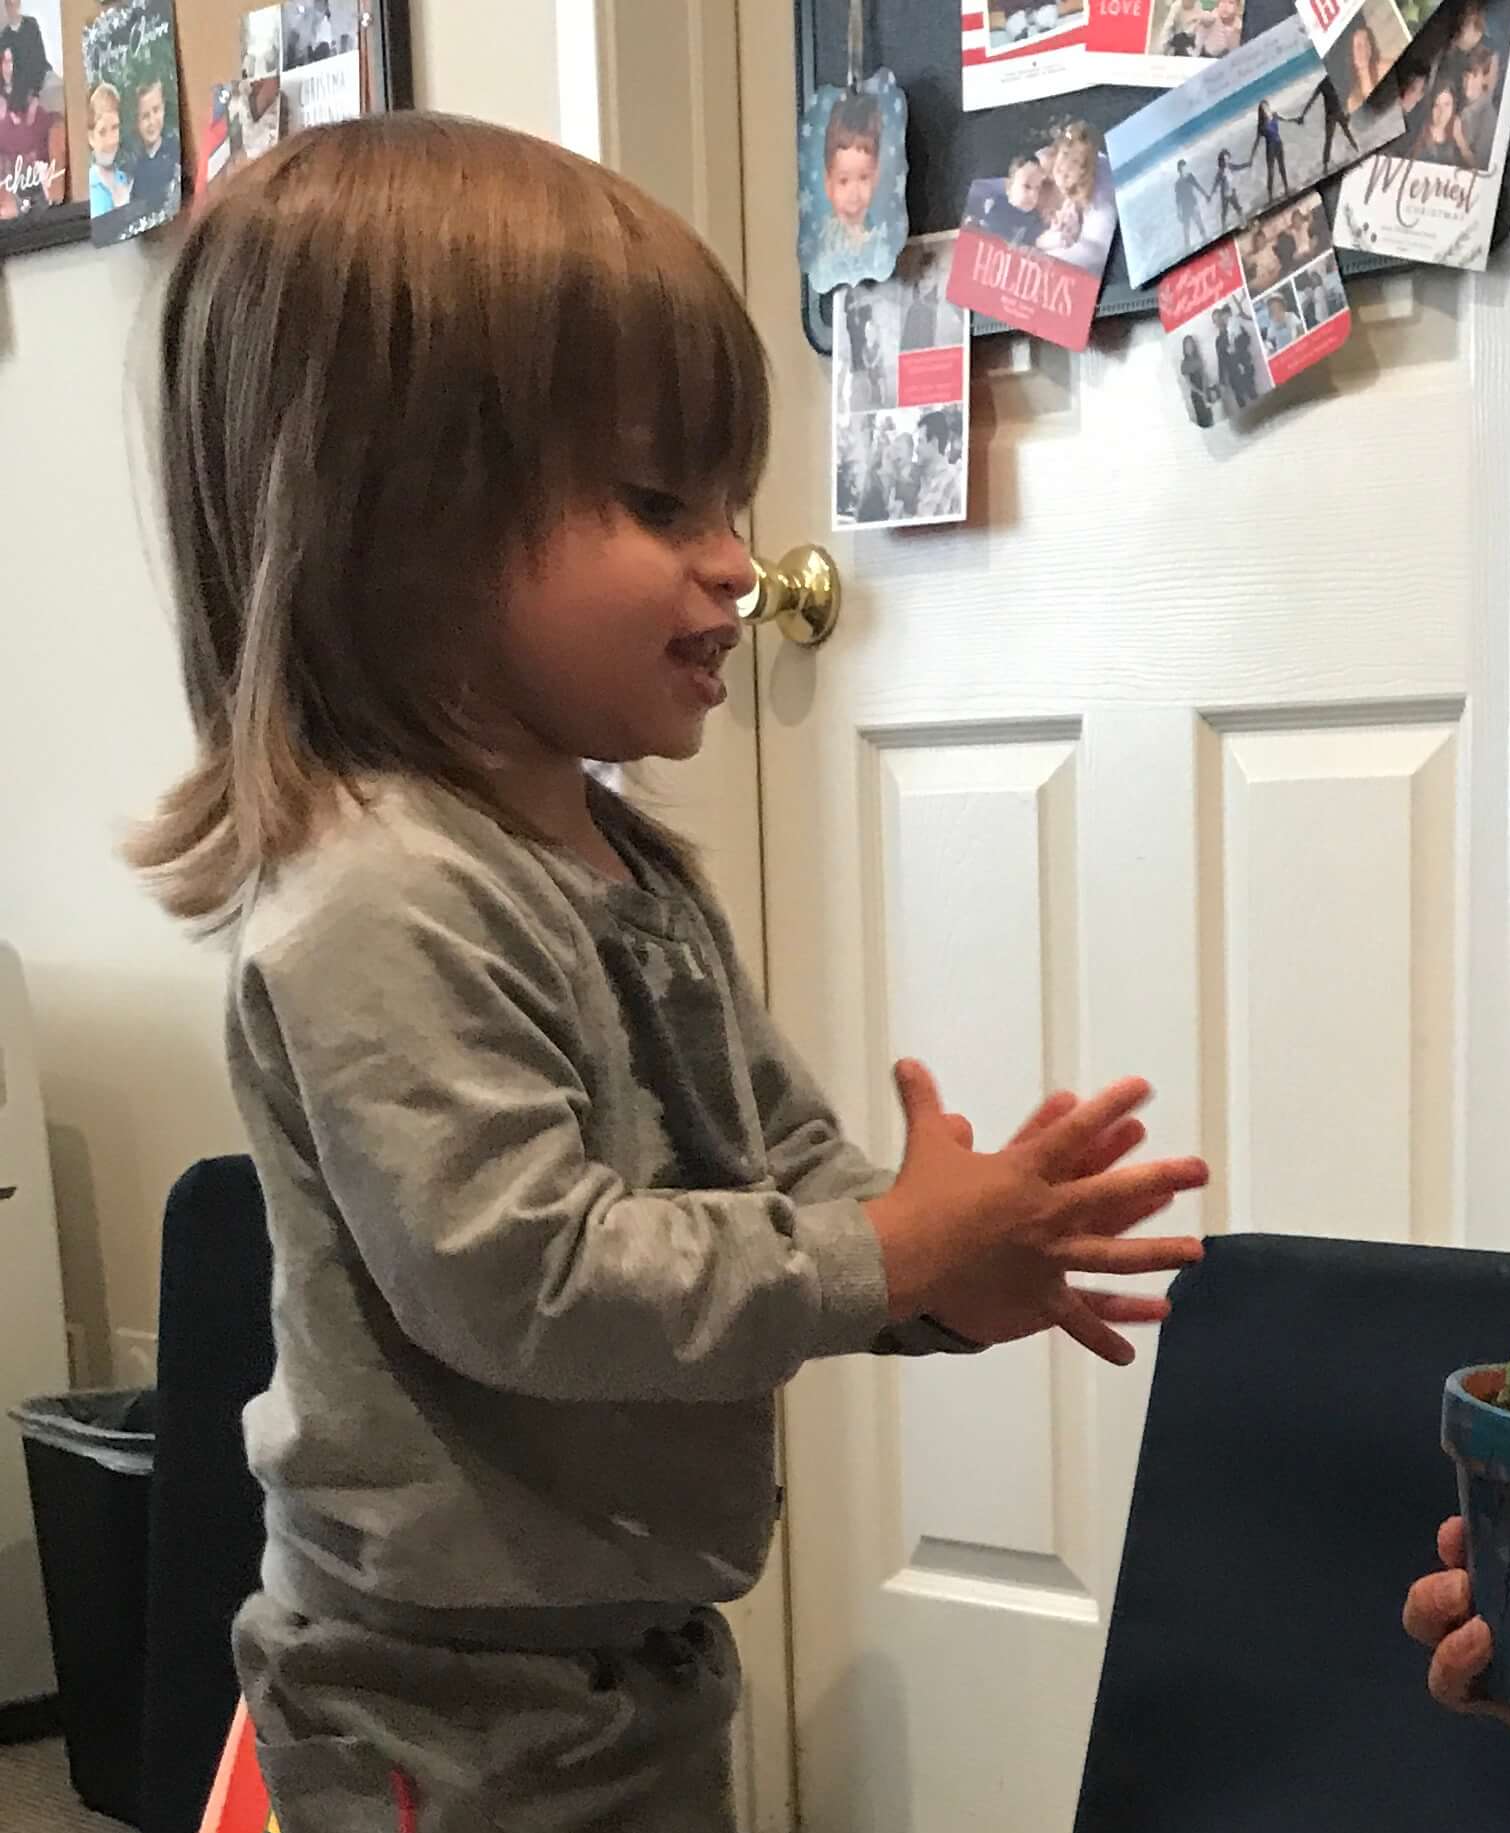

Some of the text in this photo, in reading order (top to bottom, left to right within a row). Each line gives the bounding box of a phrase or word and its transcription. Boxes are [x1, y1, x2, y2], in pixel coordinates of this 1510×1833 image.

[1100, 0, 1142, 17] LOVE
[1364, 155, 1486, 228] Merriest
[972, 240, 1076, 317] HOLIDAYS
